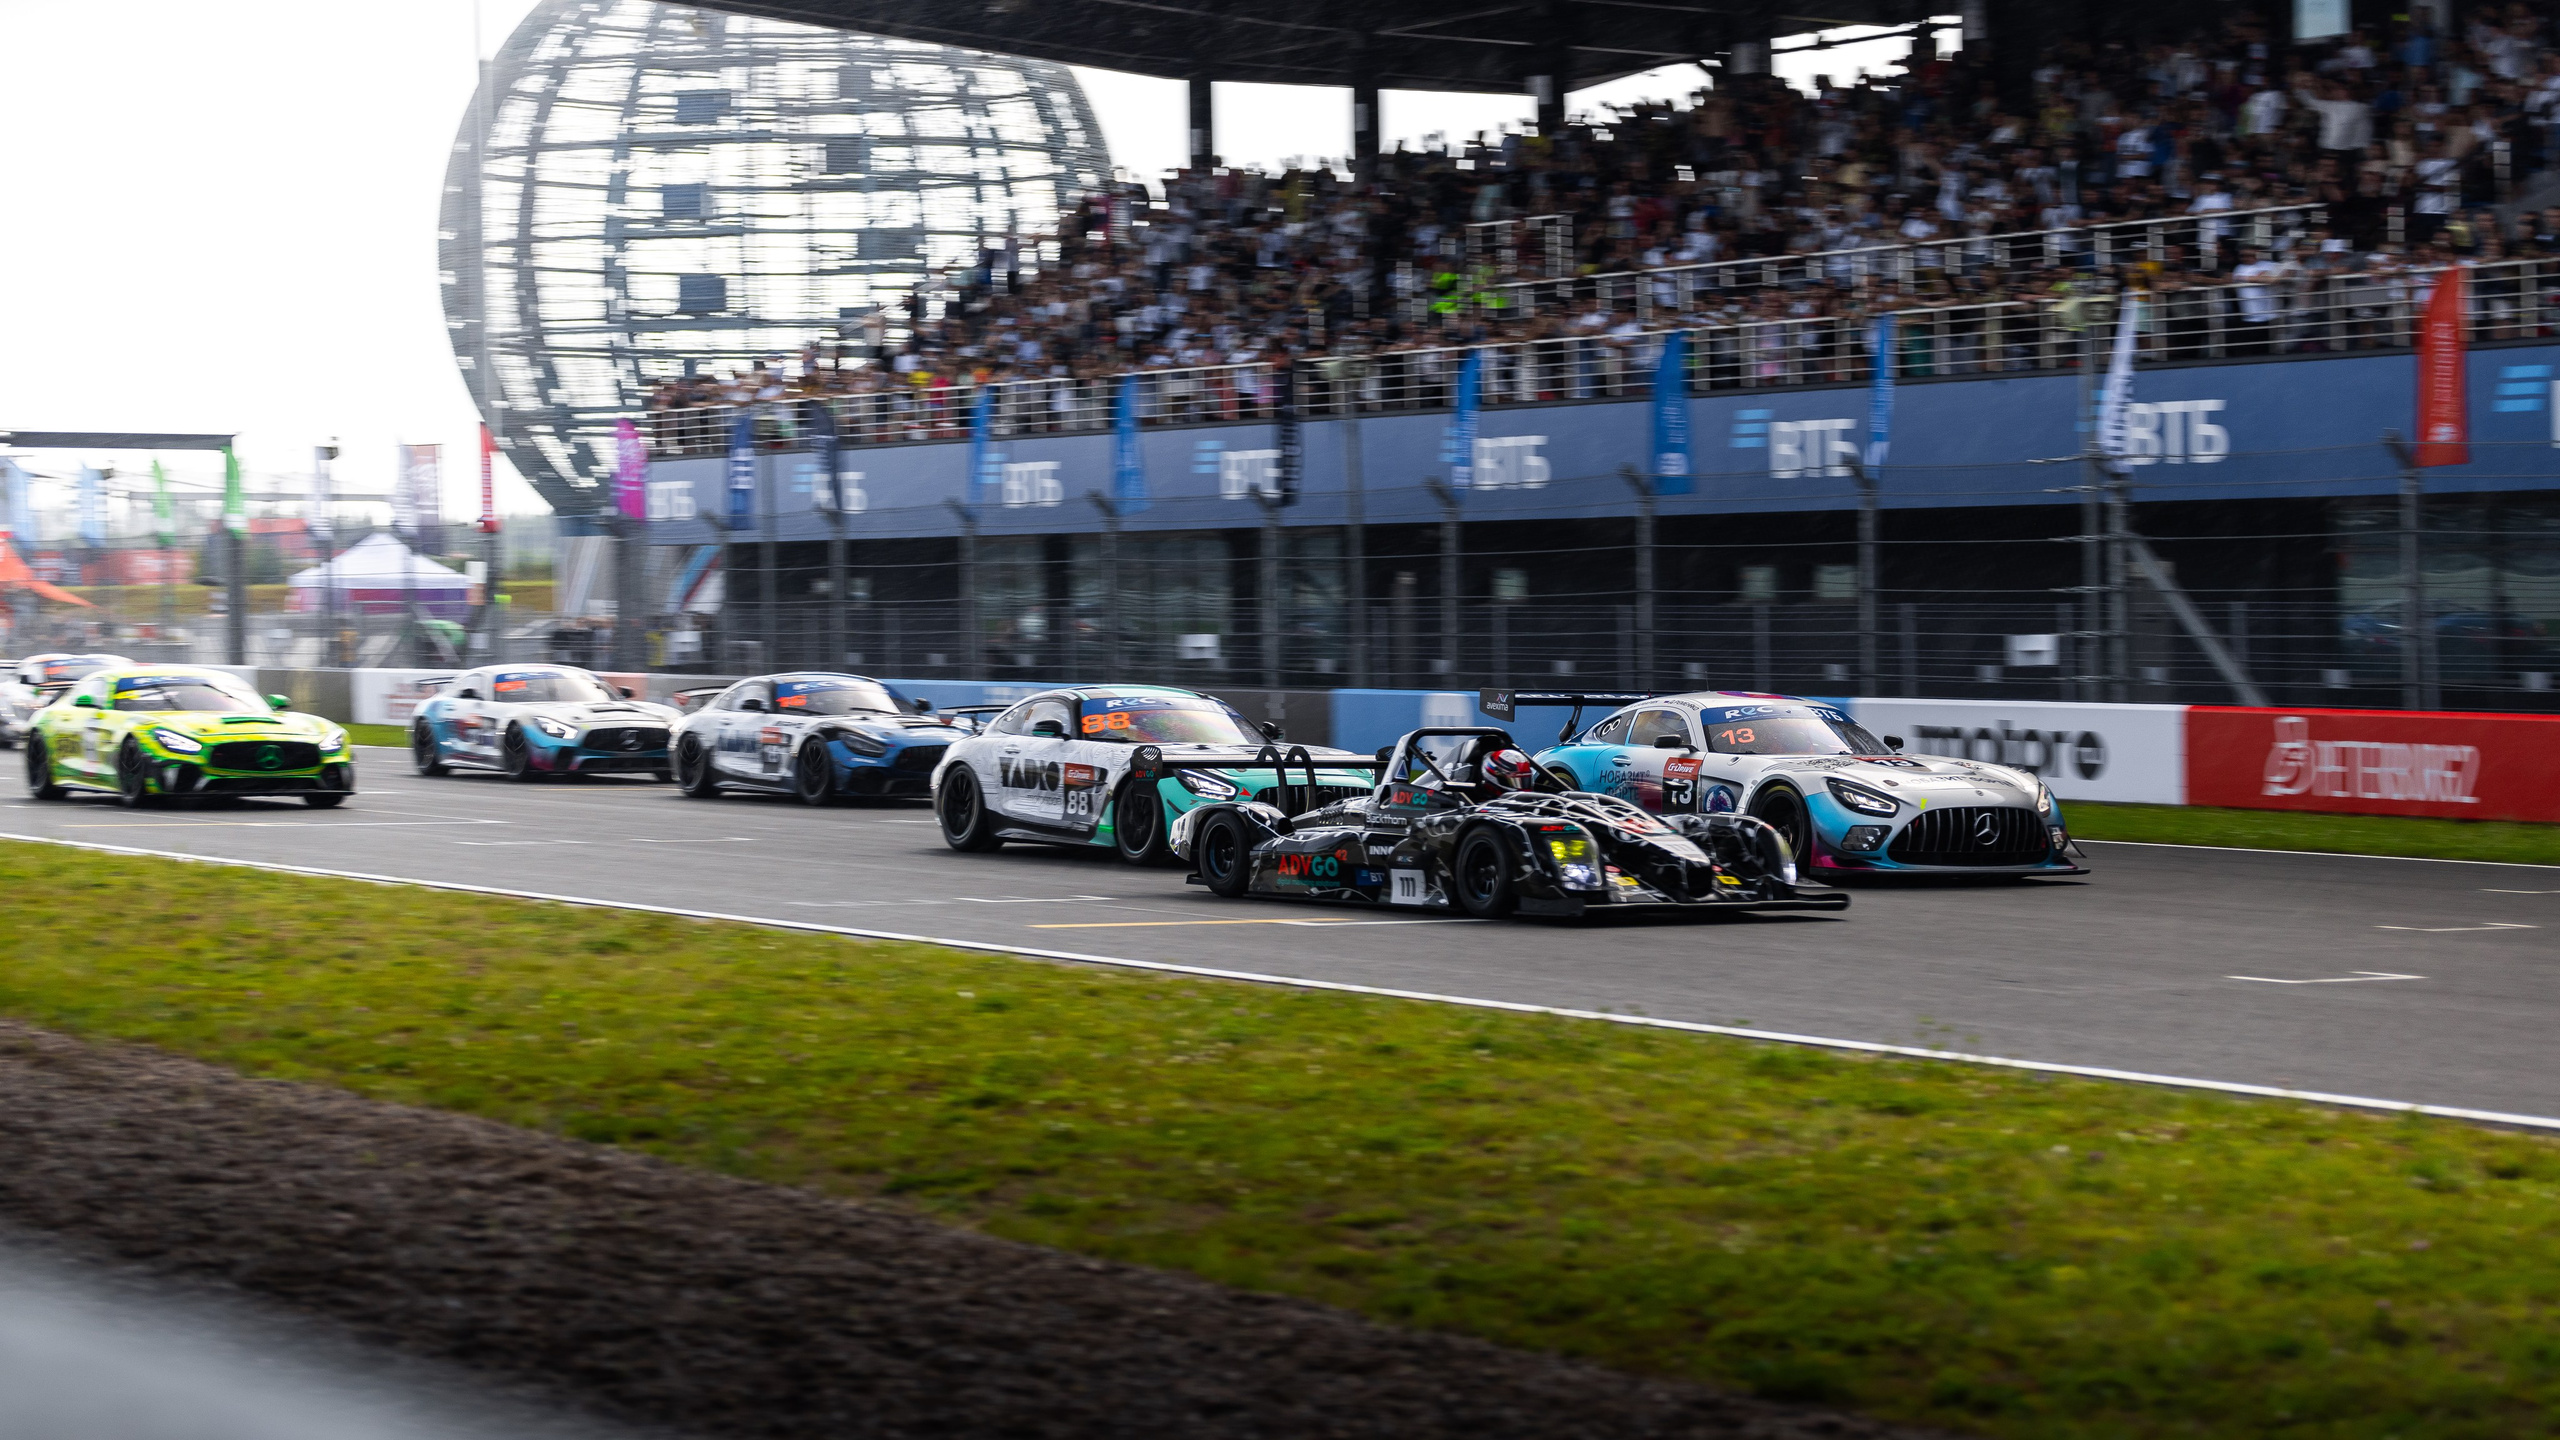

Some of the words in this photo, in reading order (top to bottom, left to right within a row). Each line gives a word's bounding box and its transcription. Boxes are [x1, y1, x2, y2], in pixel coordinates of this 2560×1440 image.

[1081, 711, 1131, 734] 88
[1721, 727, 1756, 746] 13
[1066, 790, 1089, 816] 88
[1278, 853, 1338, 877] ADVGO
[1399, 876, 1416, 898] 111
